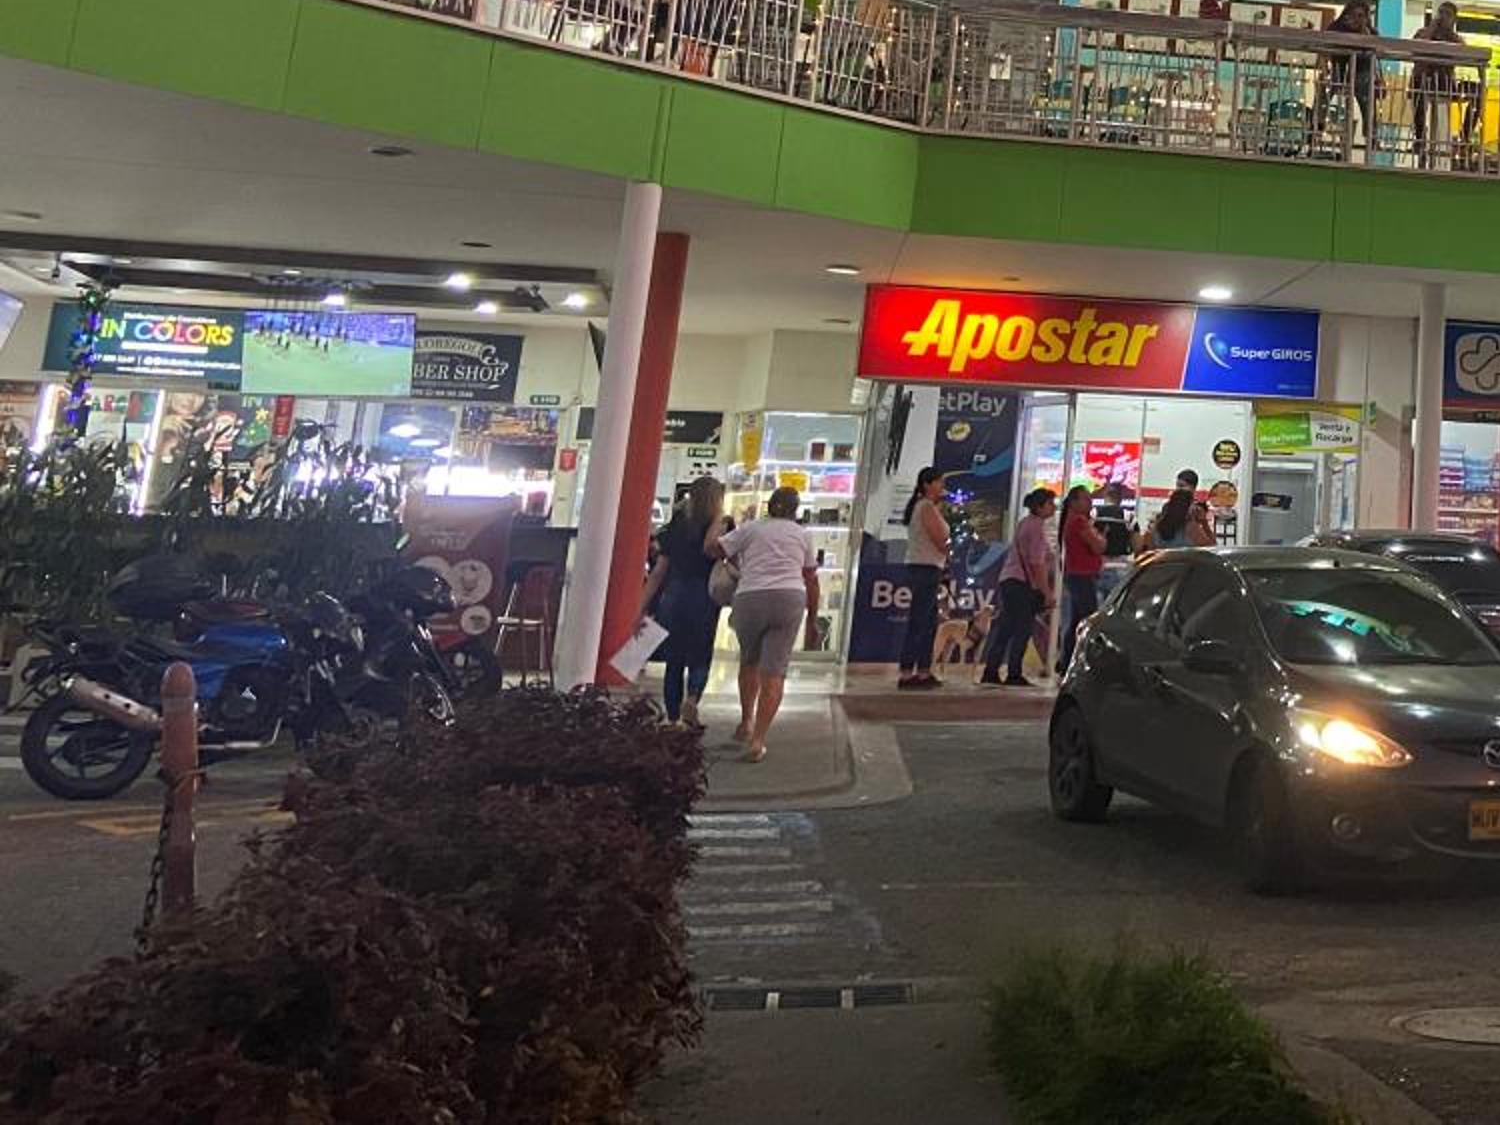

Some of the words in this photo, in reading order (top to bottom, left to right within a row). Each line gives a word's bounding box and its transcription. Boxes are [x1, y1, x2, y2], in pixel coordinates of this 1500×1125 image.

[134, 319, 235, 346] COLORS
[901, 298, 1160, 372] Apostar
[1231, 346, 1270, 360] Super
[1271, 348, 1313, 362] GIROS
[413, 362, 449, 380] BER
[453, 363, 509, 383] SHOP
[939, 390, 1008, 417] etPlay
